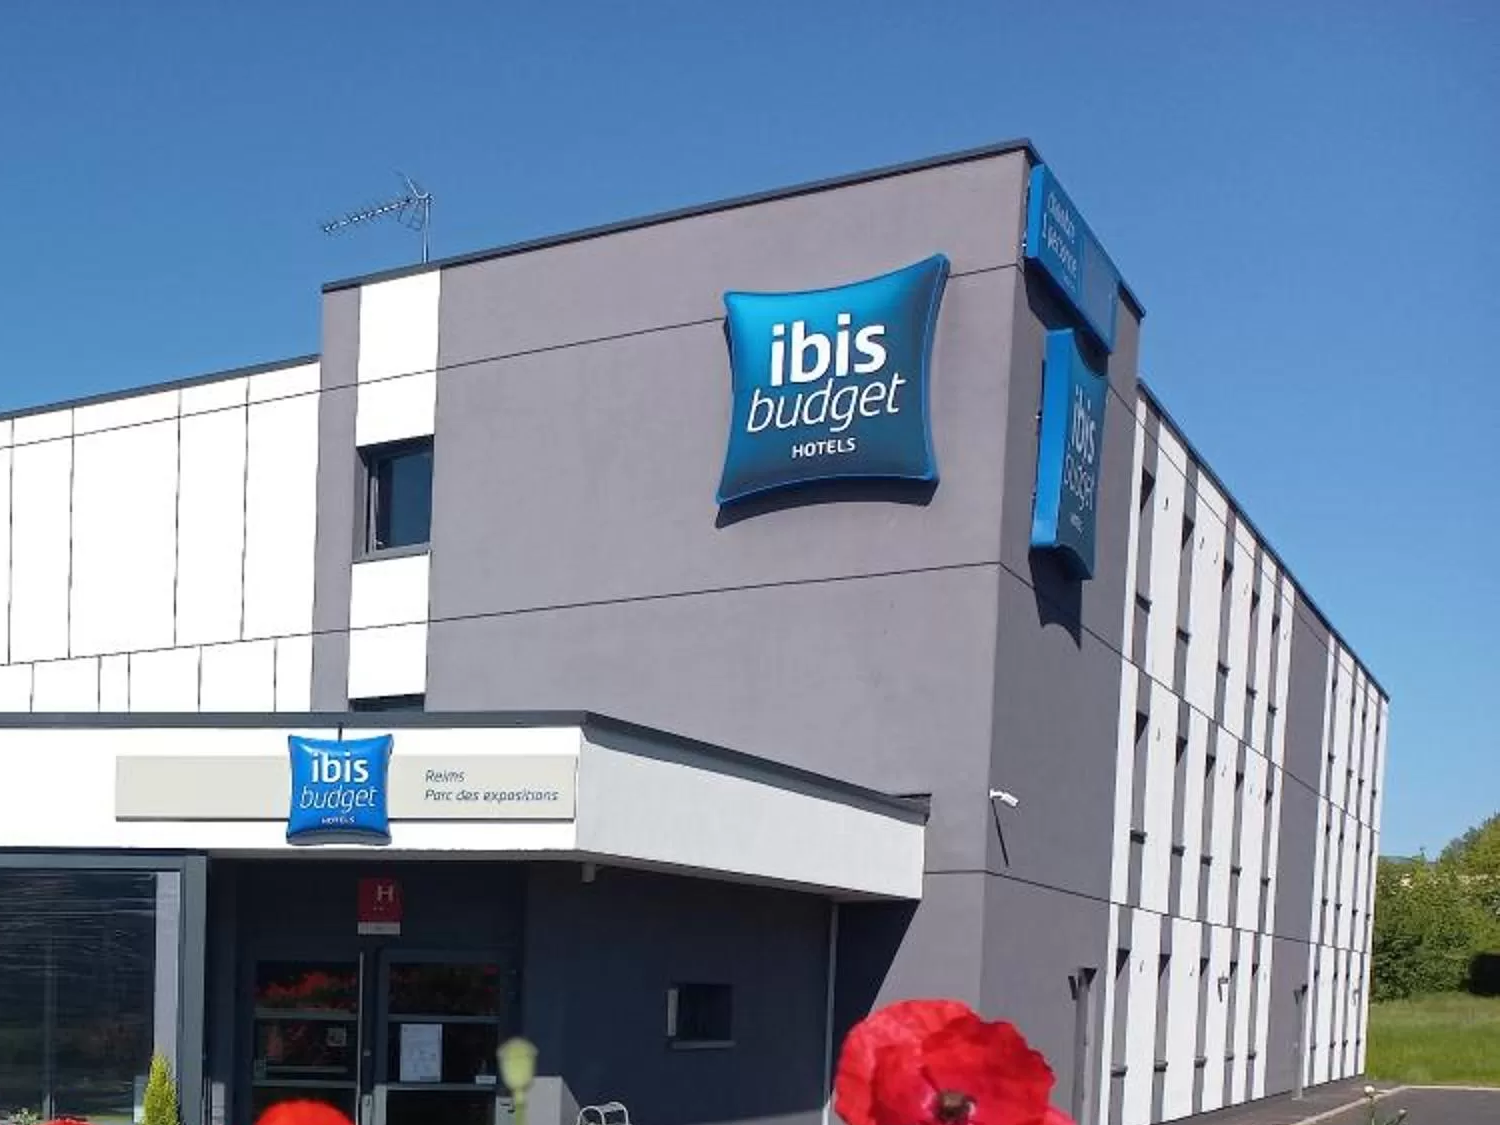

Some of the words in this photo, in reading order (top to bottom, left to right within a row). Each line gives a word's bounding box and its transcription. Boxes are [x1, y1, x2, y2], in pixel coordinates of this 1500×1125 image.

[770, 312, 887, 387] ibis
[747, 372, 906, 433] budget
[1071, 383, 1096, 464] ibis
[791, 437, 856, 459] HOTELS
[311, 751, 369, 783] ibis
[425, 769, 466, 783] Reims
[300, 784, 378, 814] budget
[424, 788, 452, 801] Parc
[456, 789, 479, 801] des
[483, 788, 559, 804] expositions
[377, 884, 394, 902] H
